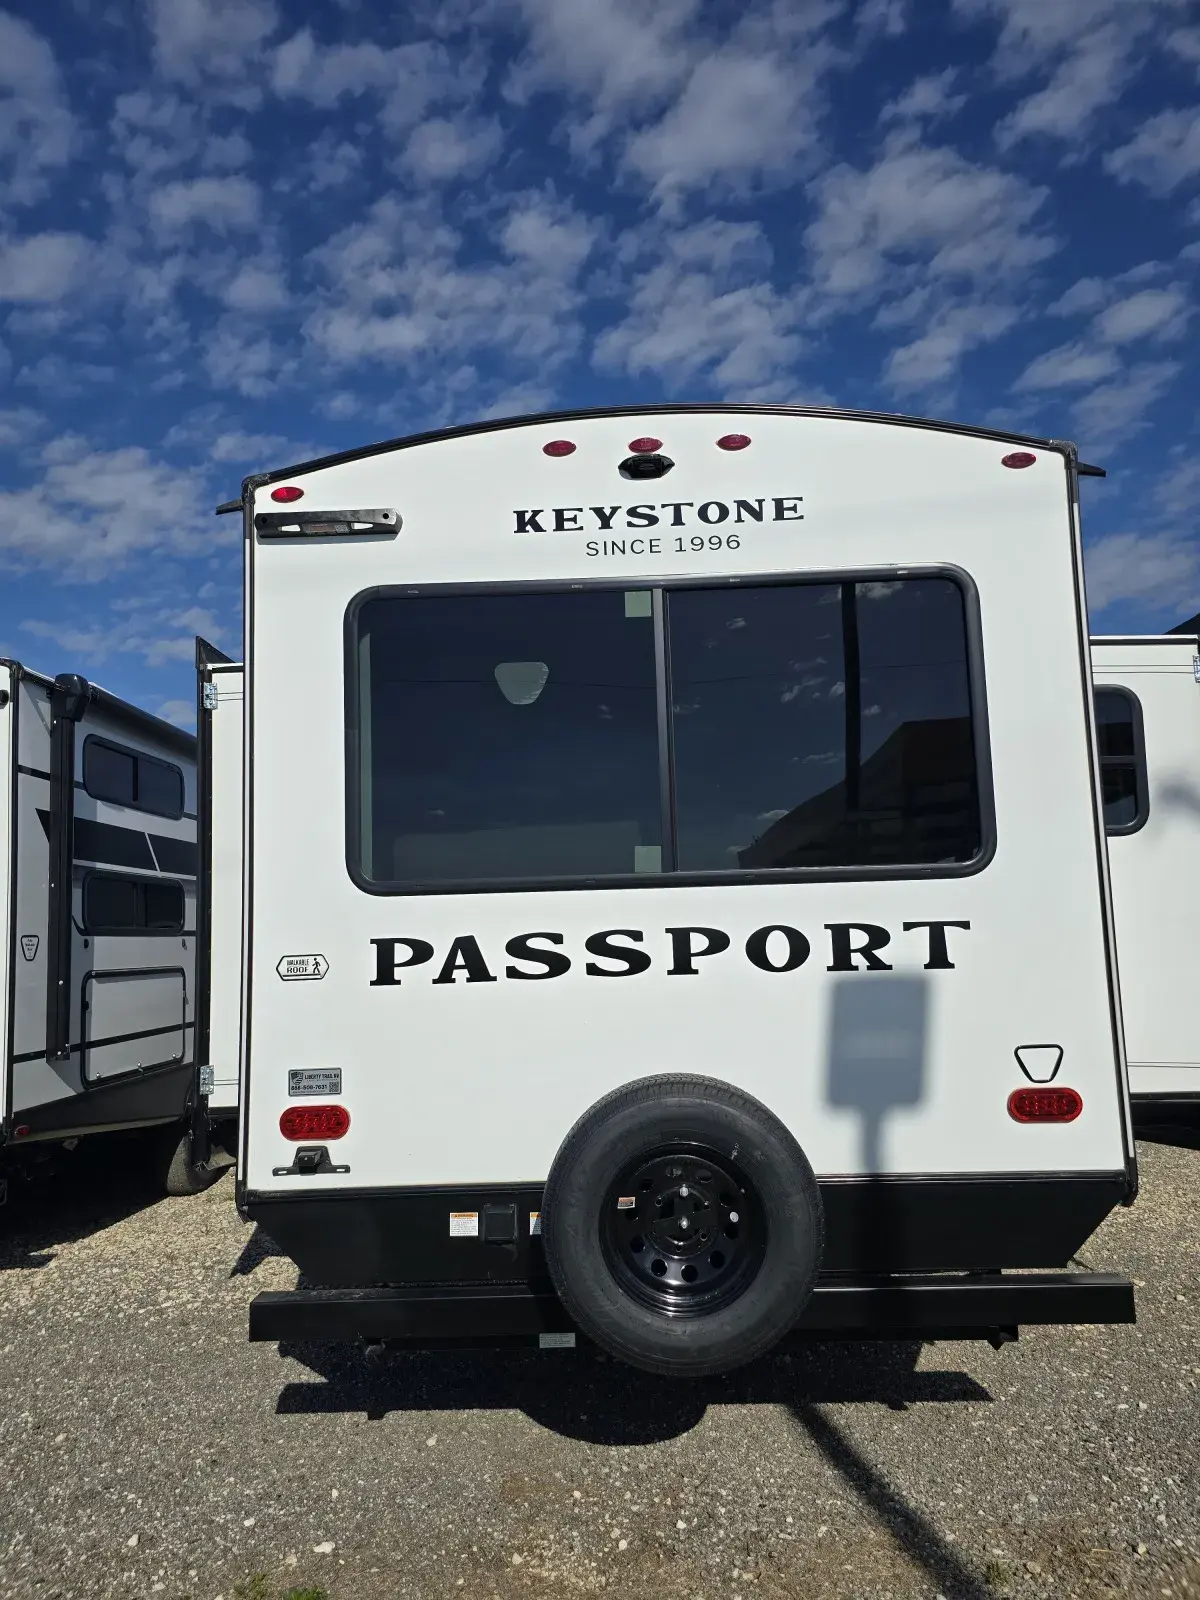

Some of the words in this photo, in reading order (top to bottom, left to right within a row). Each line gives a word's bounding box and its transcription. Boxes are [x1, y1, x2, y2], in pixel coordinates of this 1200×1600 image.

[513, 496, 804, 534] KEYSTONE
[586, 538, 662, 556] SINCE
[674, 534, 741, 553] 1996
[369, 920, 971, 986] PASSPORT
